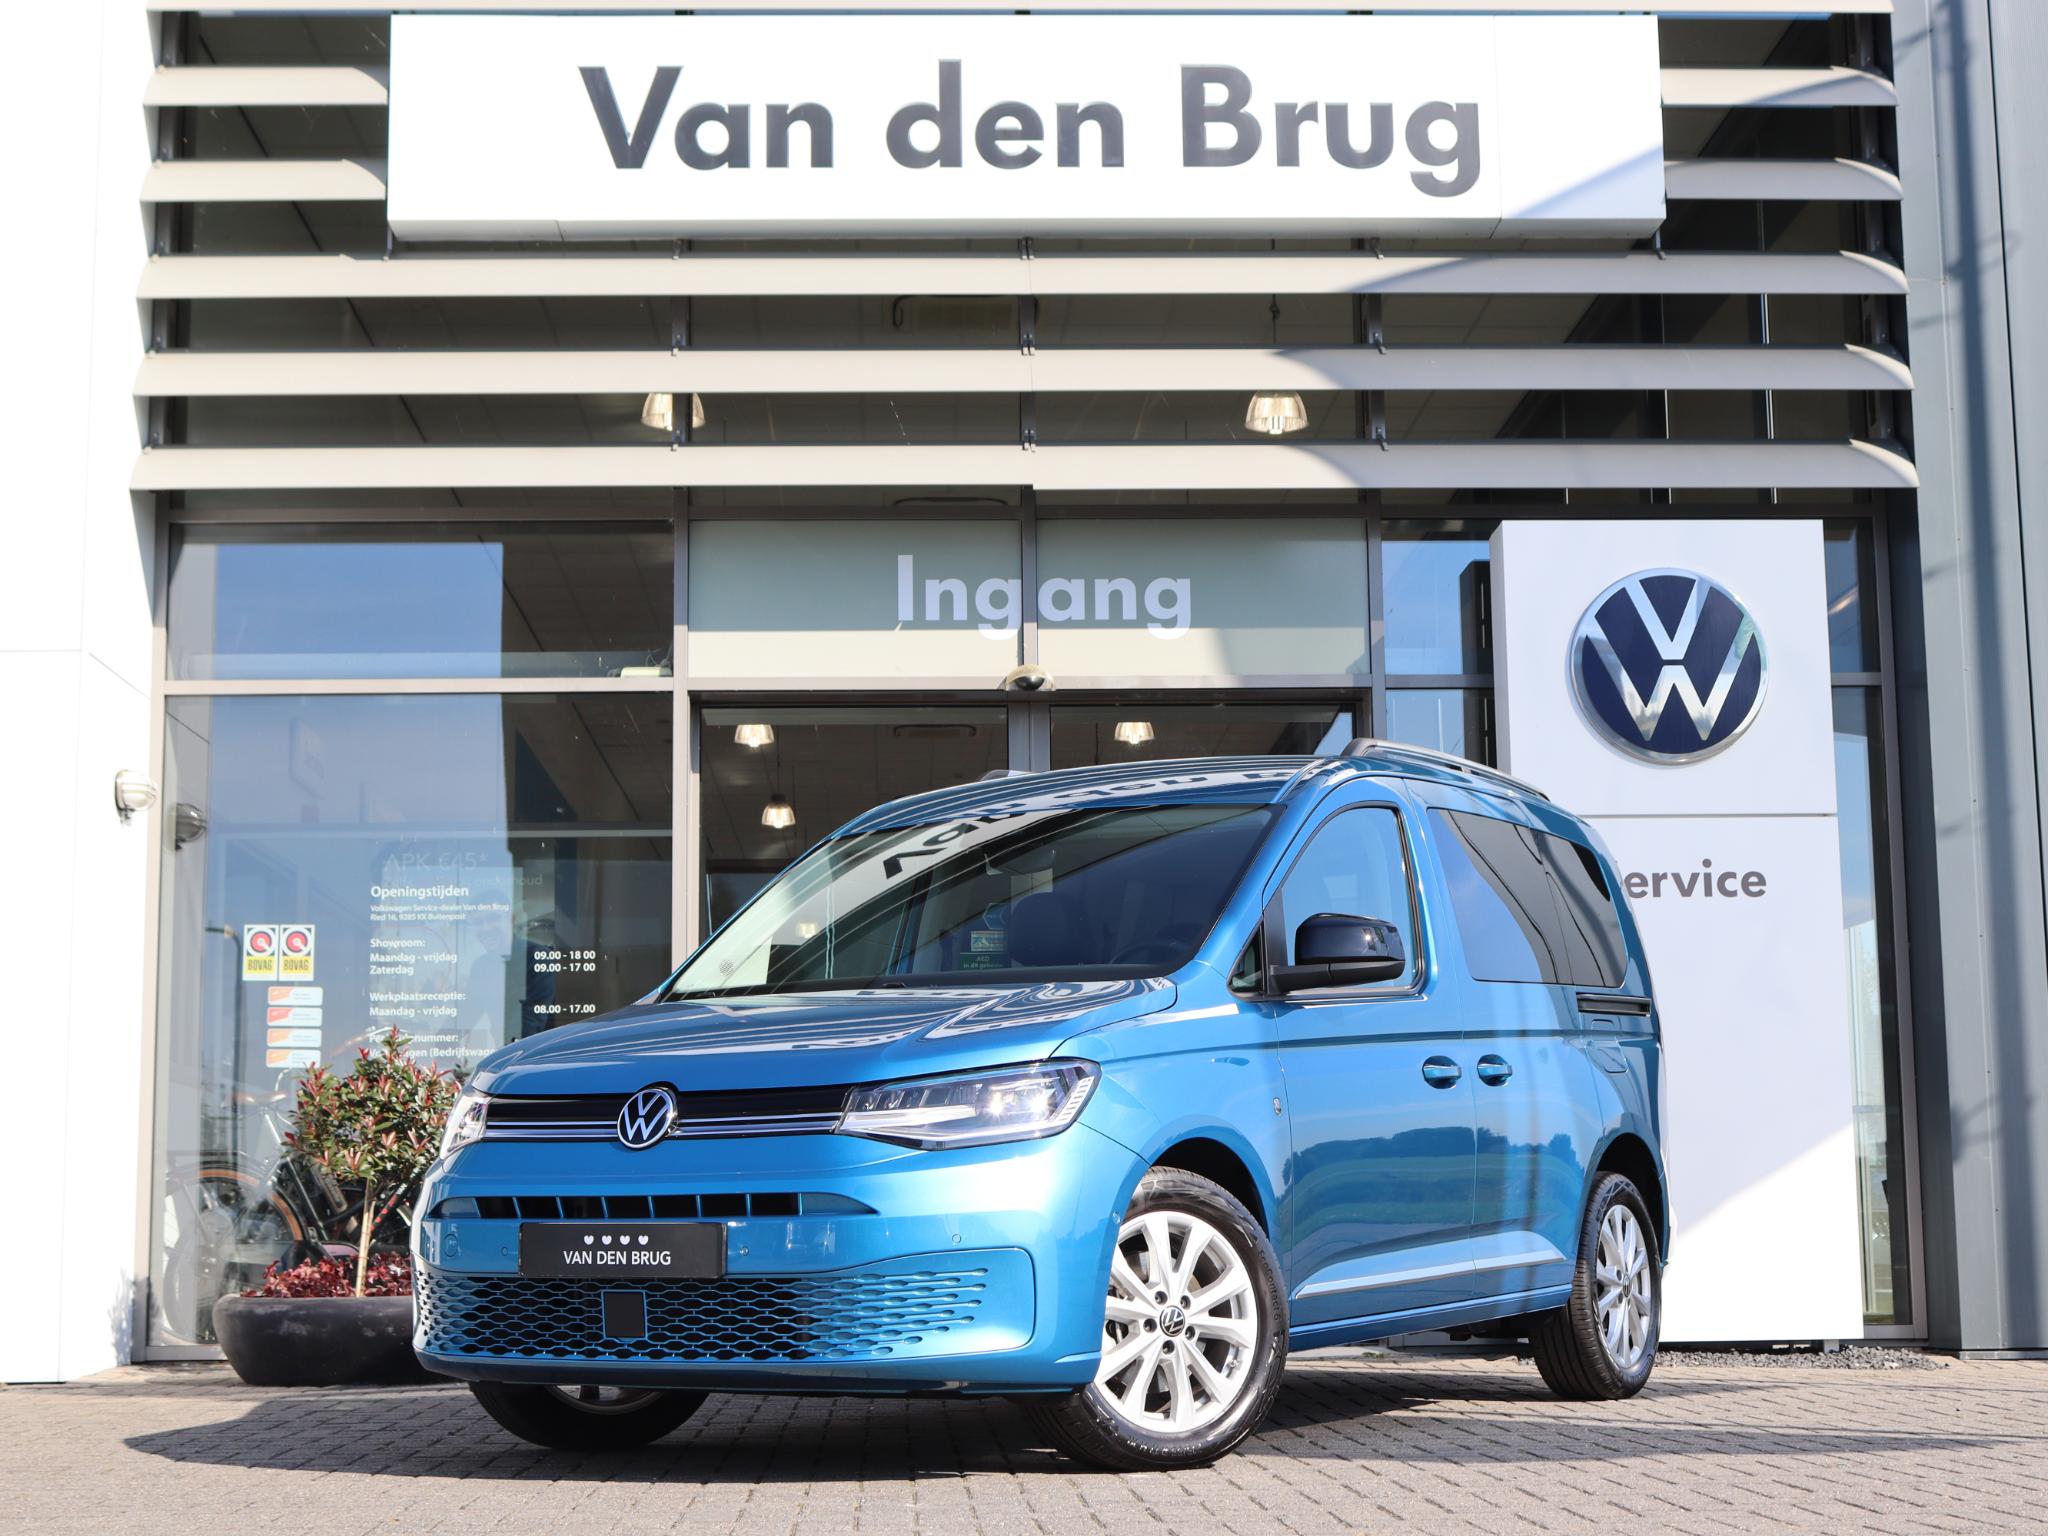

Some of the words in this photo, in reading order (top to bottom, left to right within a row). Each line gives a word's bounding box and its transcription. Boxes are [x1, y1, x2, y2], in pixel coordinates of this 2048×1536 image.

[577, 64, 834, 171] Van
[885, 58, 1125, 170] den
[1179, 63, 1481, 198] Brug
[897, 554, 1191, 641] Ingang
[1623, 857, 1767, 899] ervice
[371, 885, 469, 900] Openingstijden
[370, 939, 426, 950] Showroom:
[370, 952, 416, 964] Maandag
[423, 952, 457, 964] vrijdag
[534, 951, 561, 960] 09.00
[247, 959, 273, 971] BOVAG
[283, 959, 310, 971] BOVAG
[370, 965, 415, 976] Zaterdag
[534, 963, 561, 972] 09.00
[370, 991, 466, 1004] Werkplaatsreceptie:
[370, 1006, 416, 1018] Maandag
[422, 1006, 457, 1018] vrijdag
[534, 1005, 561, 1014] 08.00
[569, 1004, 596, 1014] 17.00
[563, 1250, 592, 1265] VAN
[596, 1250, 627, 1265] DEN
[631, 1250, 672, 1266] BRUG
